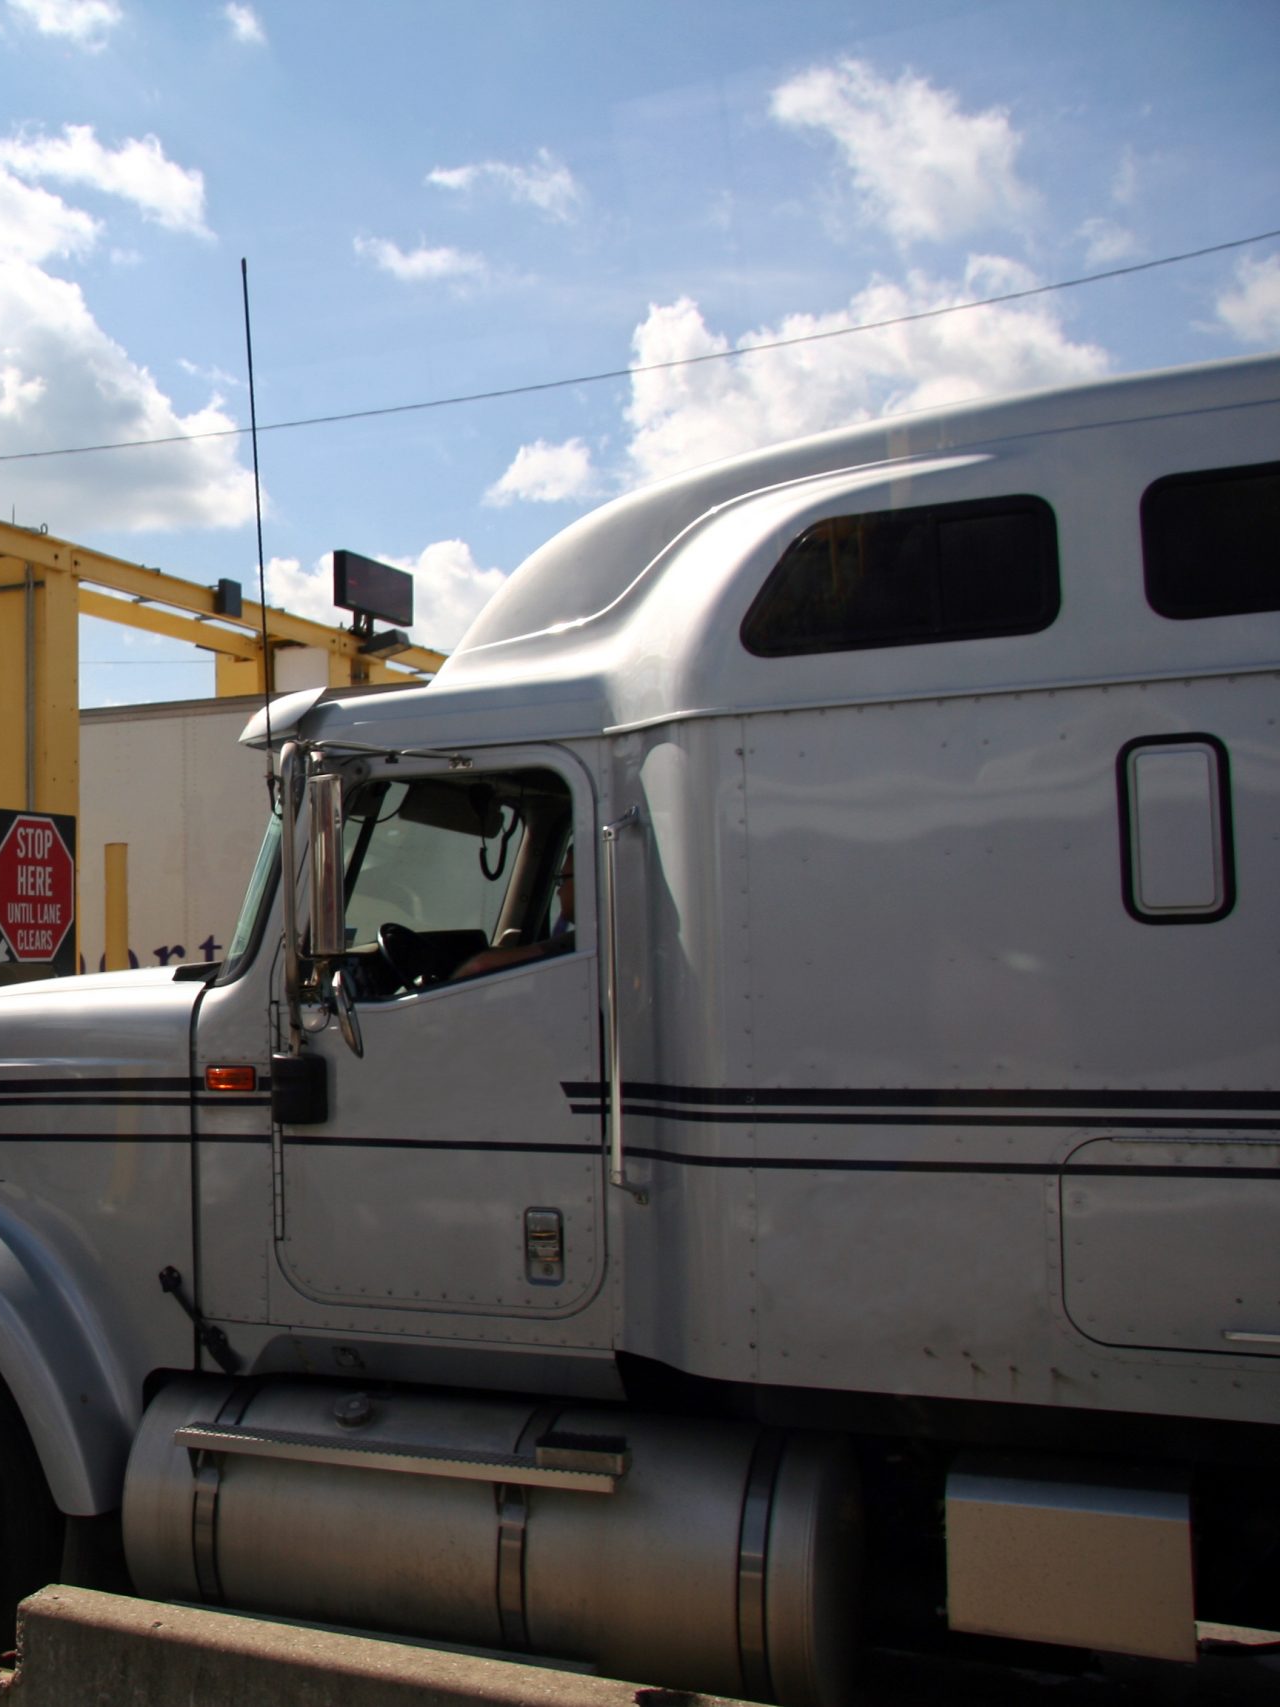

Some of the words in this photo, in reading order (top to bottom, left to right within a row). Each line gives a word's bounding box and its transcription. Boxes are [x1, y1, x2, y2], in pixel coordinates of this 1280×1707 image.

[16, 827, 53, 860] STOP
[17, 865, 53, 897] HERE
[7, 902, 35, 924] UNTIL
[37, 903, 62, 925] LANE
[17, 930, 53, 950] CLEARS
